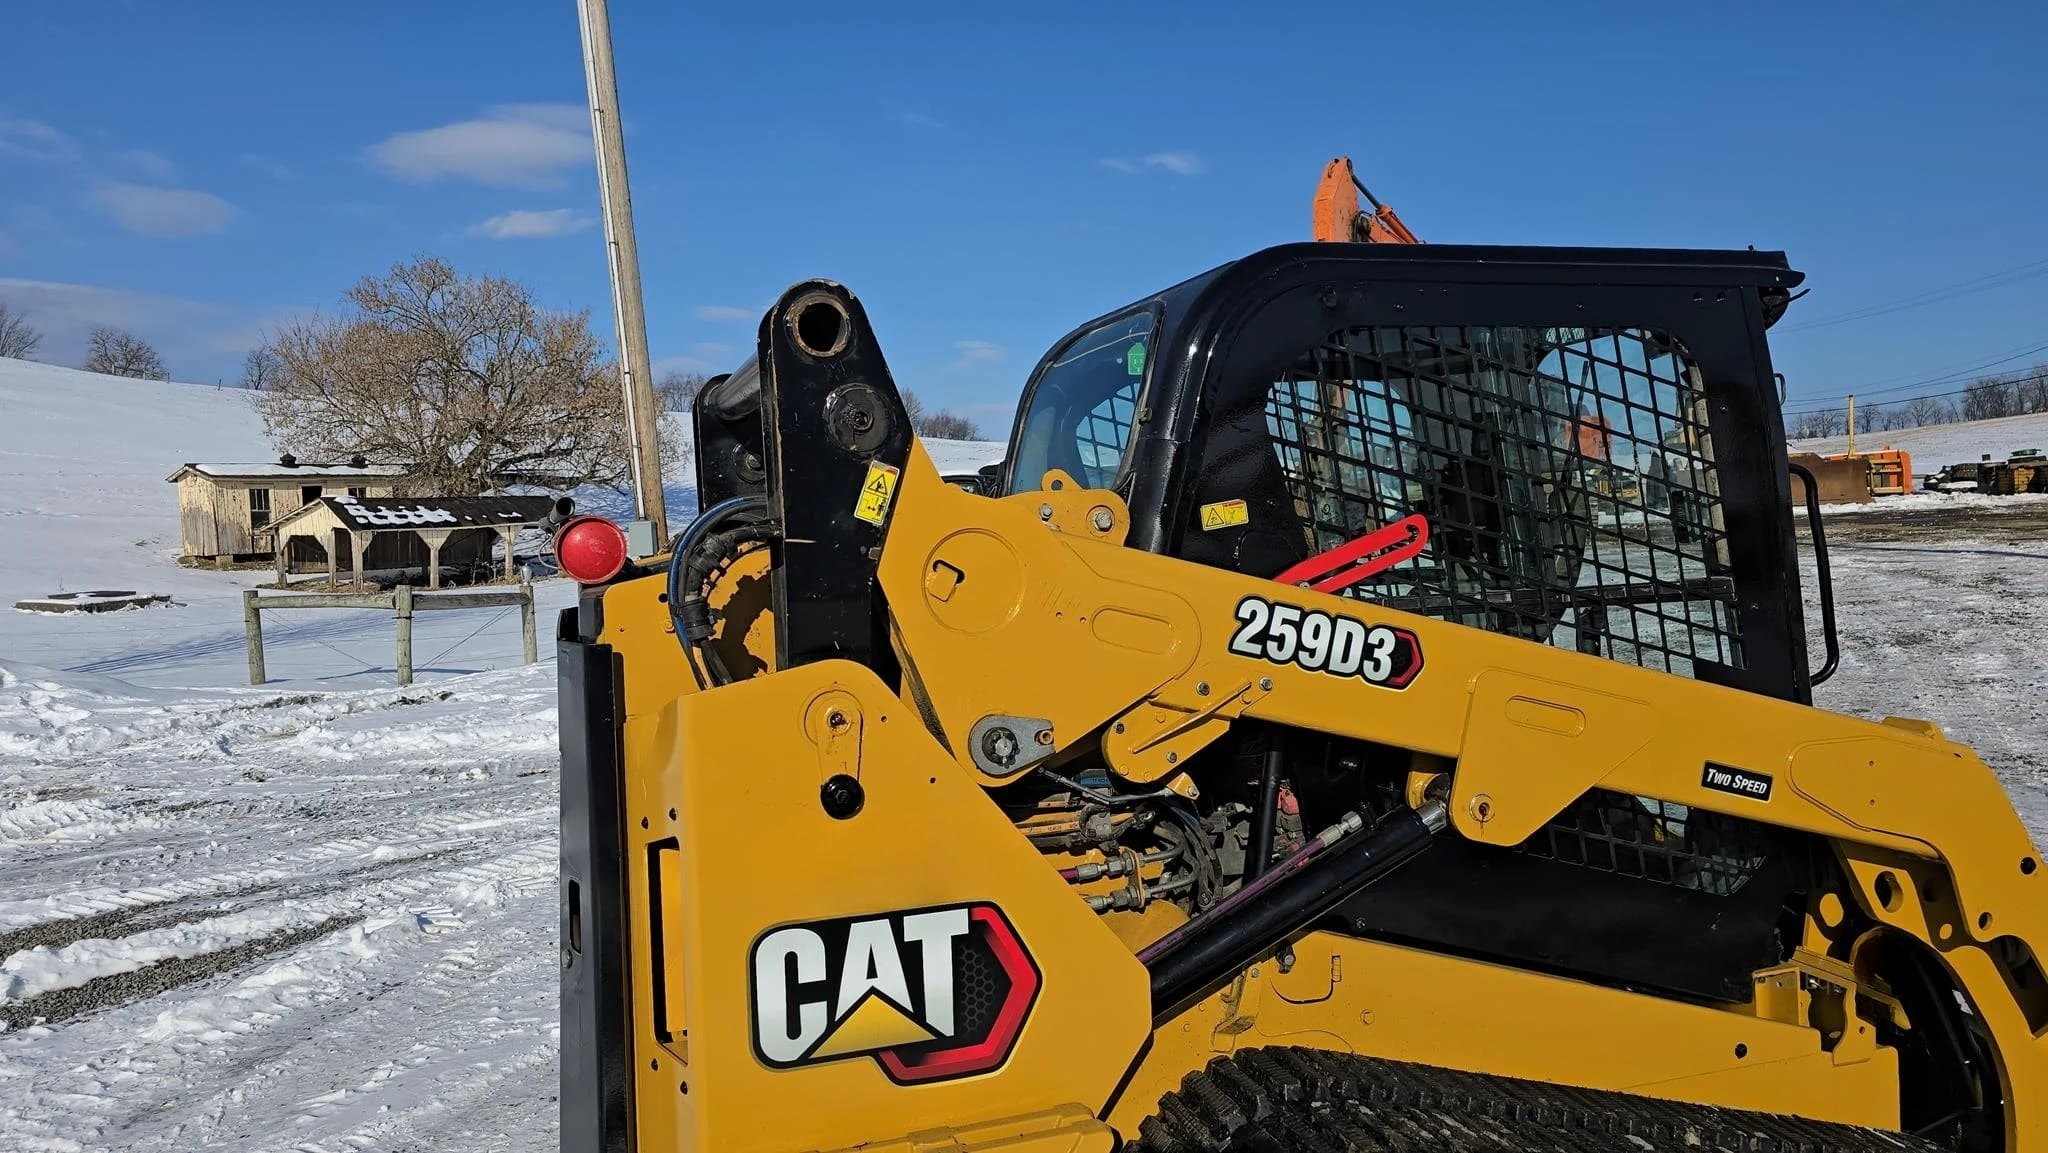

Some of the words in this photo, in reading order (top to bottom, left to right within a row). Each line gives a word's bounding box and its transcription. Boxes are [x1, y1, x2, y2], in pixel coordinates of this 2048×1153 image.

[1232, 599, 1396, 681] 259D3
[1707, 768, 1732, 786] TWO
[1732, 775, 1768, 794] SPEED
[755, 908, 969, 1062] CAT
